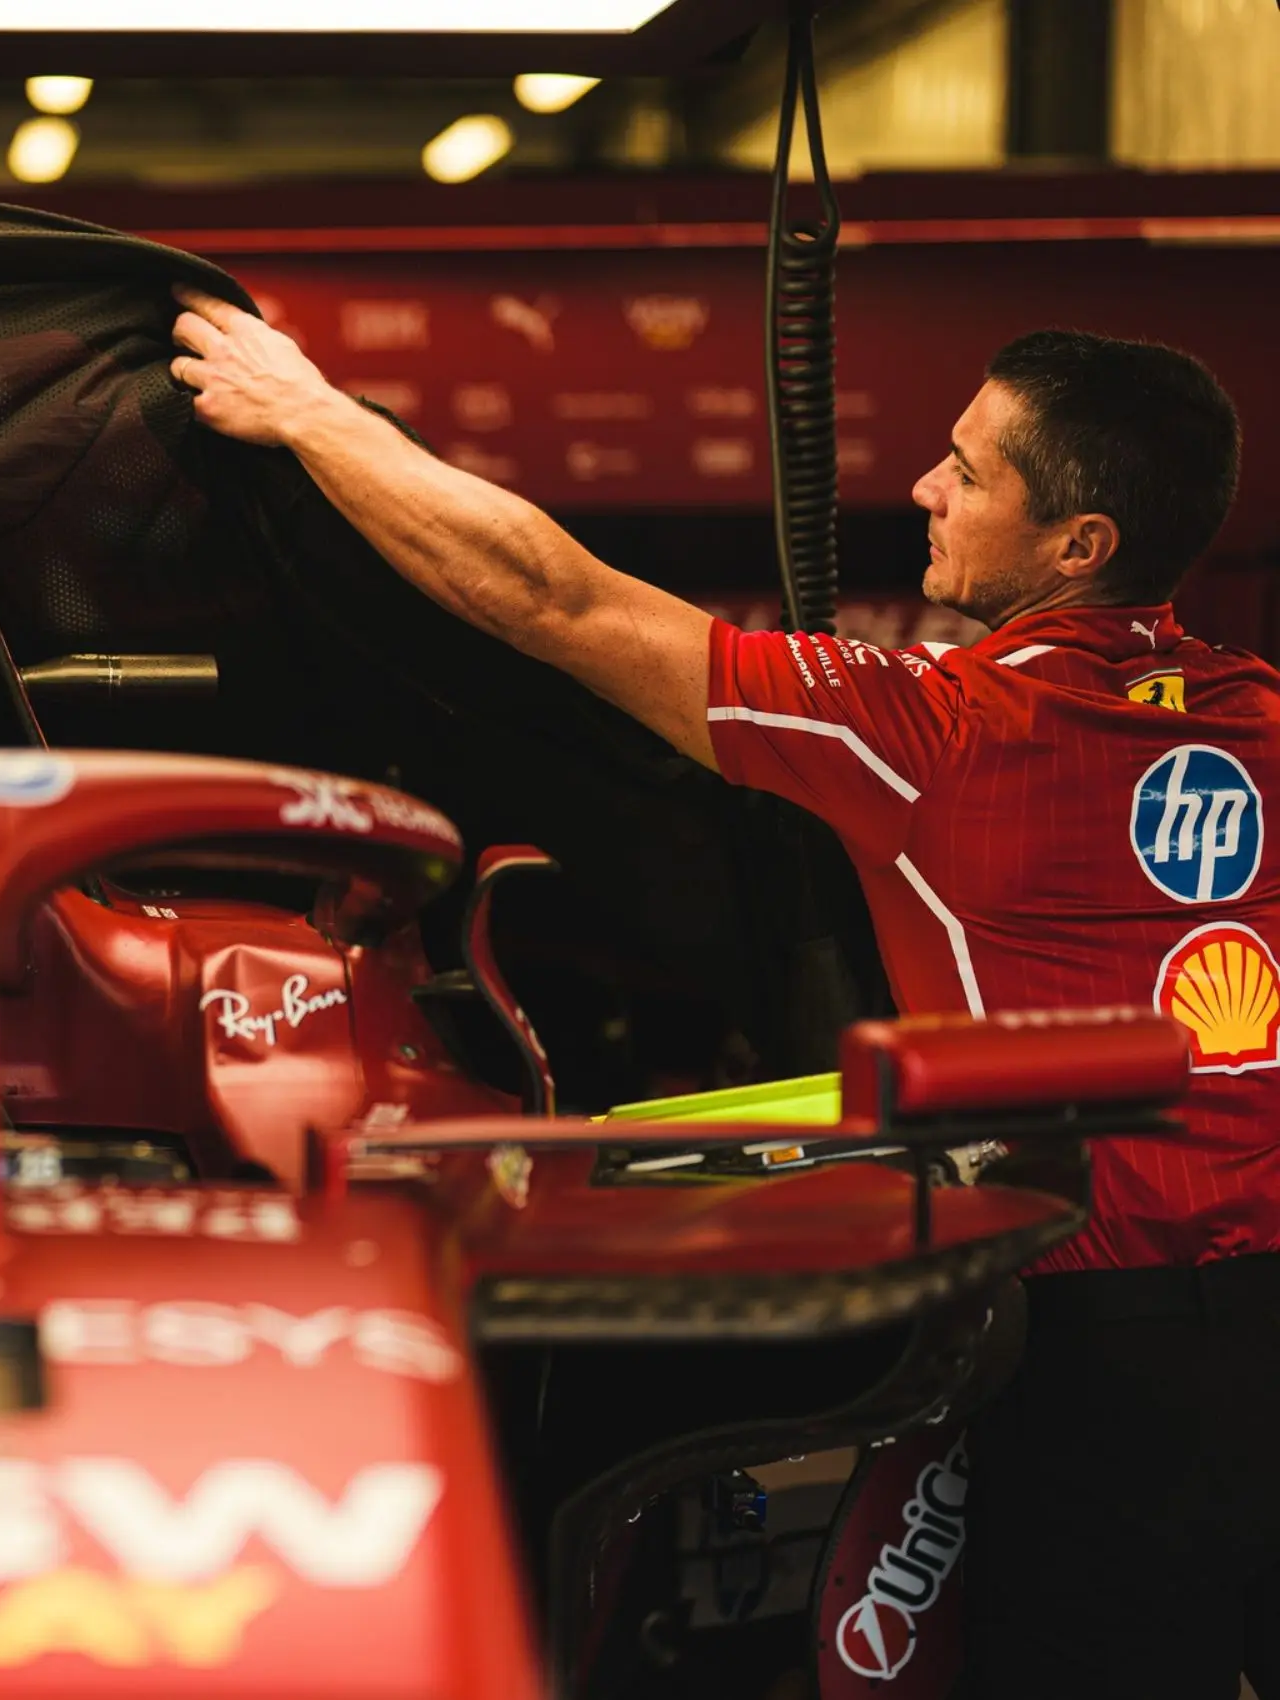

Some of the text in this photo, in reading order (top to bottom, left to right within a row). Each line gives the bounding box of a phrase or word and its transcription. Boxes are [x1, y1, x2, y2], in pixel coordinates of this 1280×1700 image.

[815, 646, 841, 688] MILLE
[1152, 748, 1250, 902] hp
[199, 974, 347, 1046] Ray-Ban
